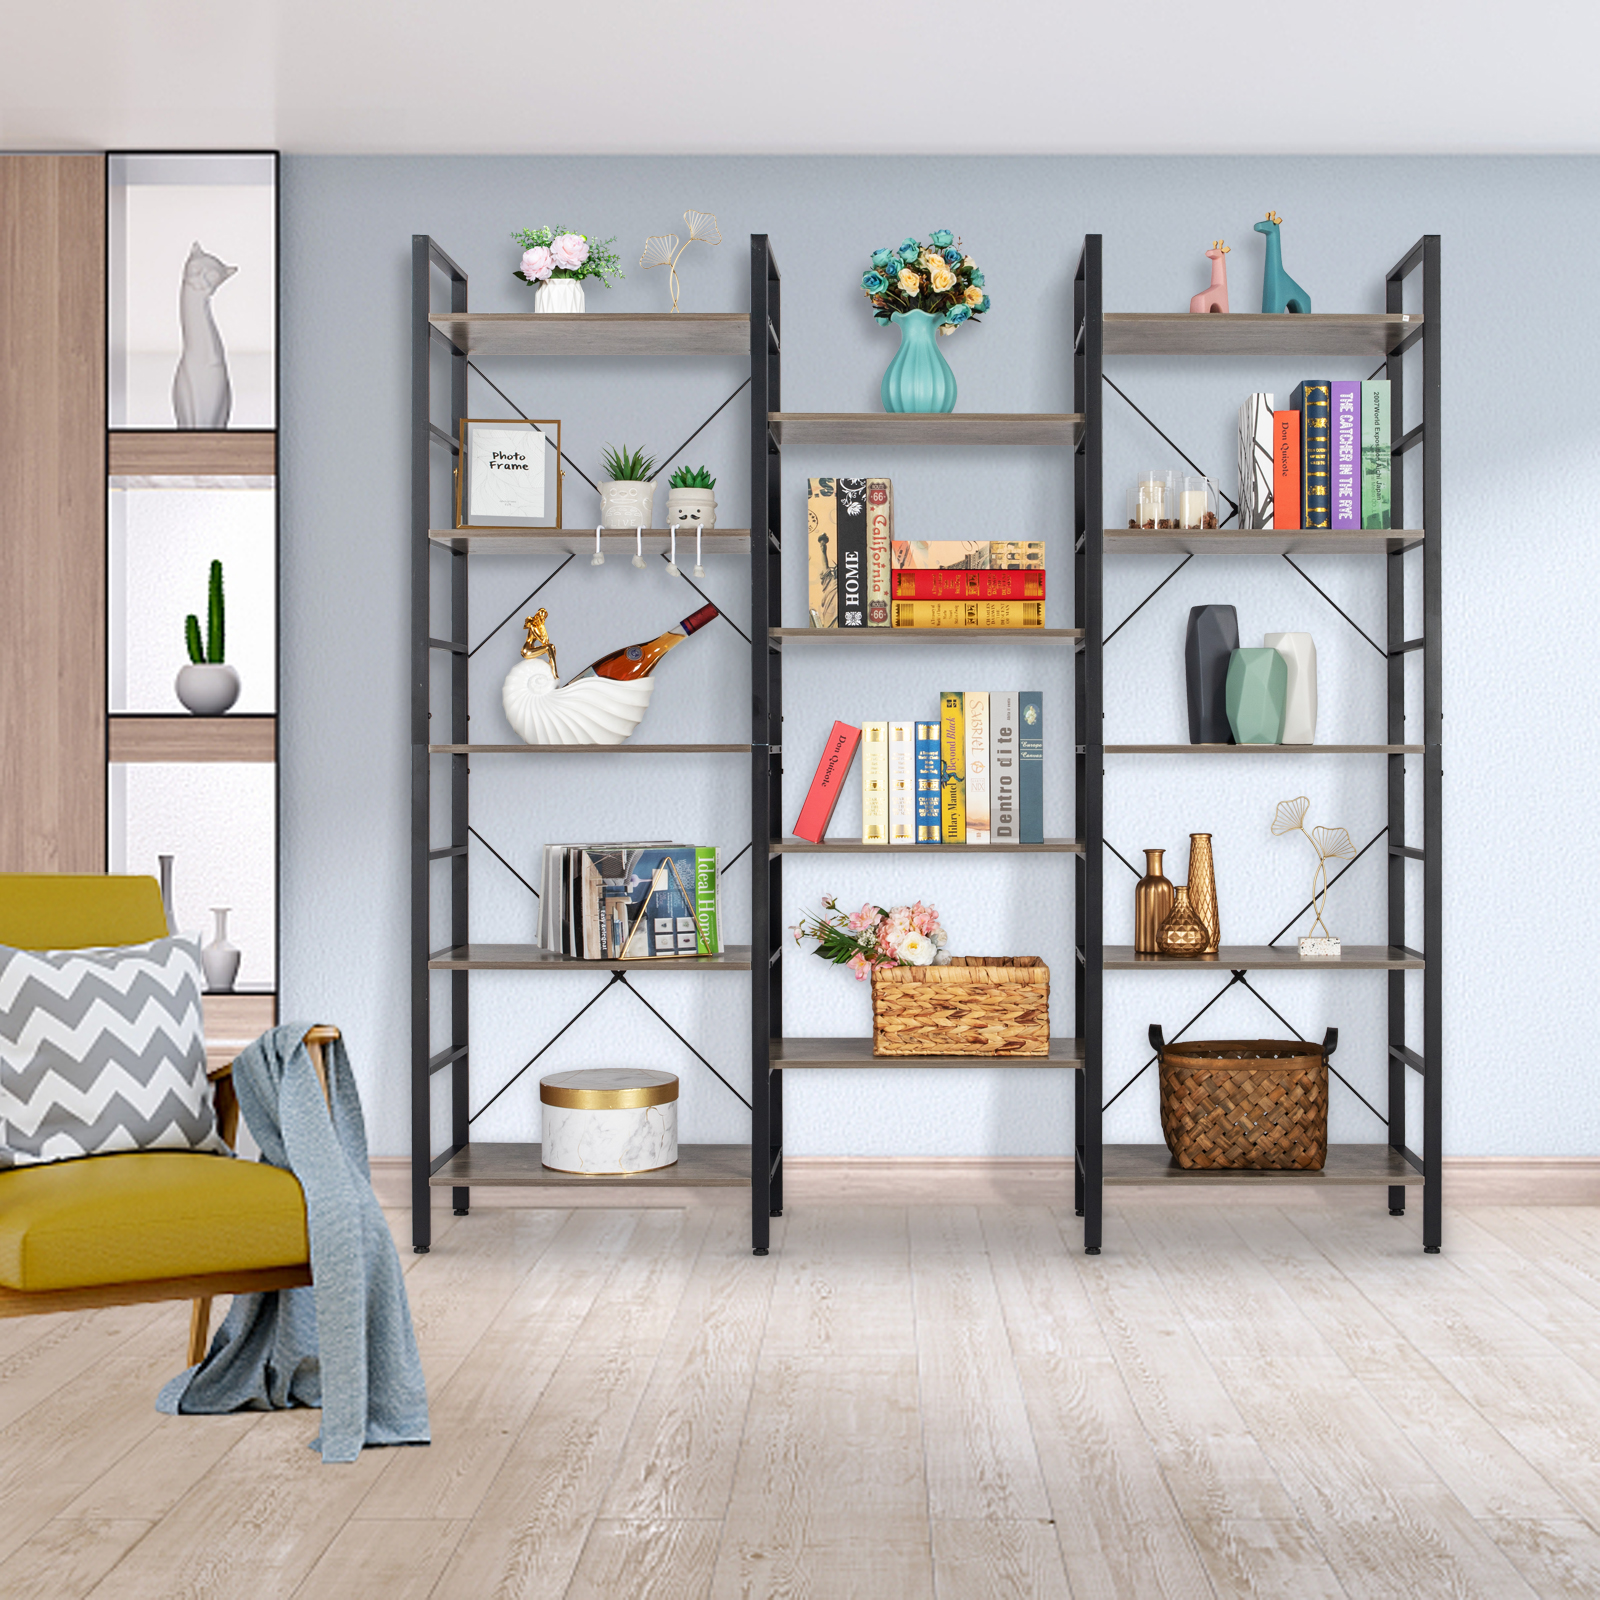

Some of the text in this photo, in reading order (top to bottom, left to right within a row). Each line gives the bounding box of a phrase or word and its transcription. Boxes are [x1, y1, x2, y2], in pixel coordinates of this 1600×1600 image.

[1281, 422, 1289, 441] Don
[489, 461, 529, 470] Frame
[492, 451, 526, 461] Photo
[1338, 392, 1354, 520] THE CATCHER IN THE RYE
[873, 492, 884, 502] 66
[1374, 480, 1382, 501] Japan
[871, 514, 887, 593] California
[845, 550, 860, 606] HOME
[873, 609, 884, 619] 66
[969, 699, 985, 757] SABRIEL
[997, 727, 1012, 744] te
[833, 735, 847, 755] Don
[945, 717, 959, 771] Beyond Black
[1021, 741, 1042, 749] Europe
[947, 782, 960, 838] Hilary Mantel
[997, 775, 1012, 838] Dentro
[697, 856, 715, 946] Ideal Home
